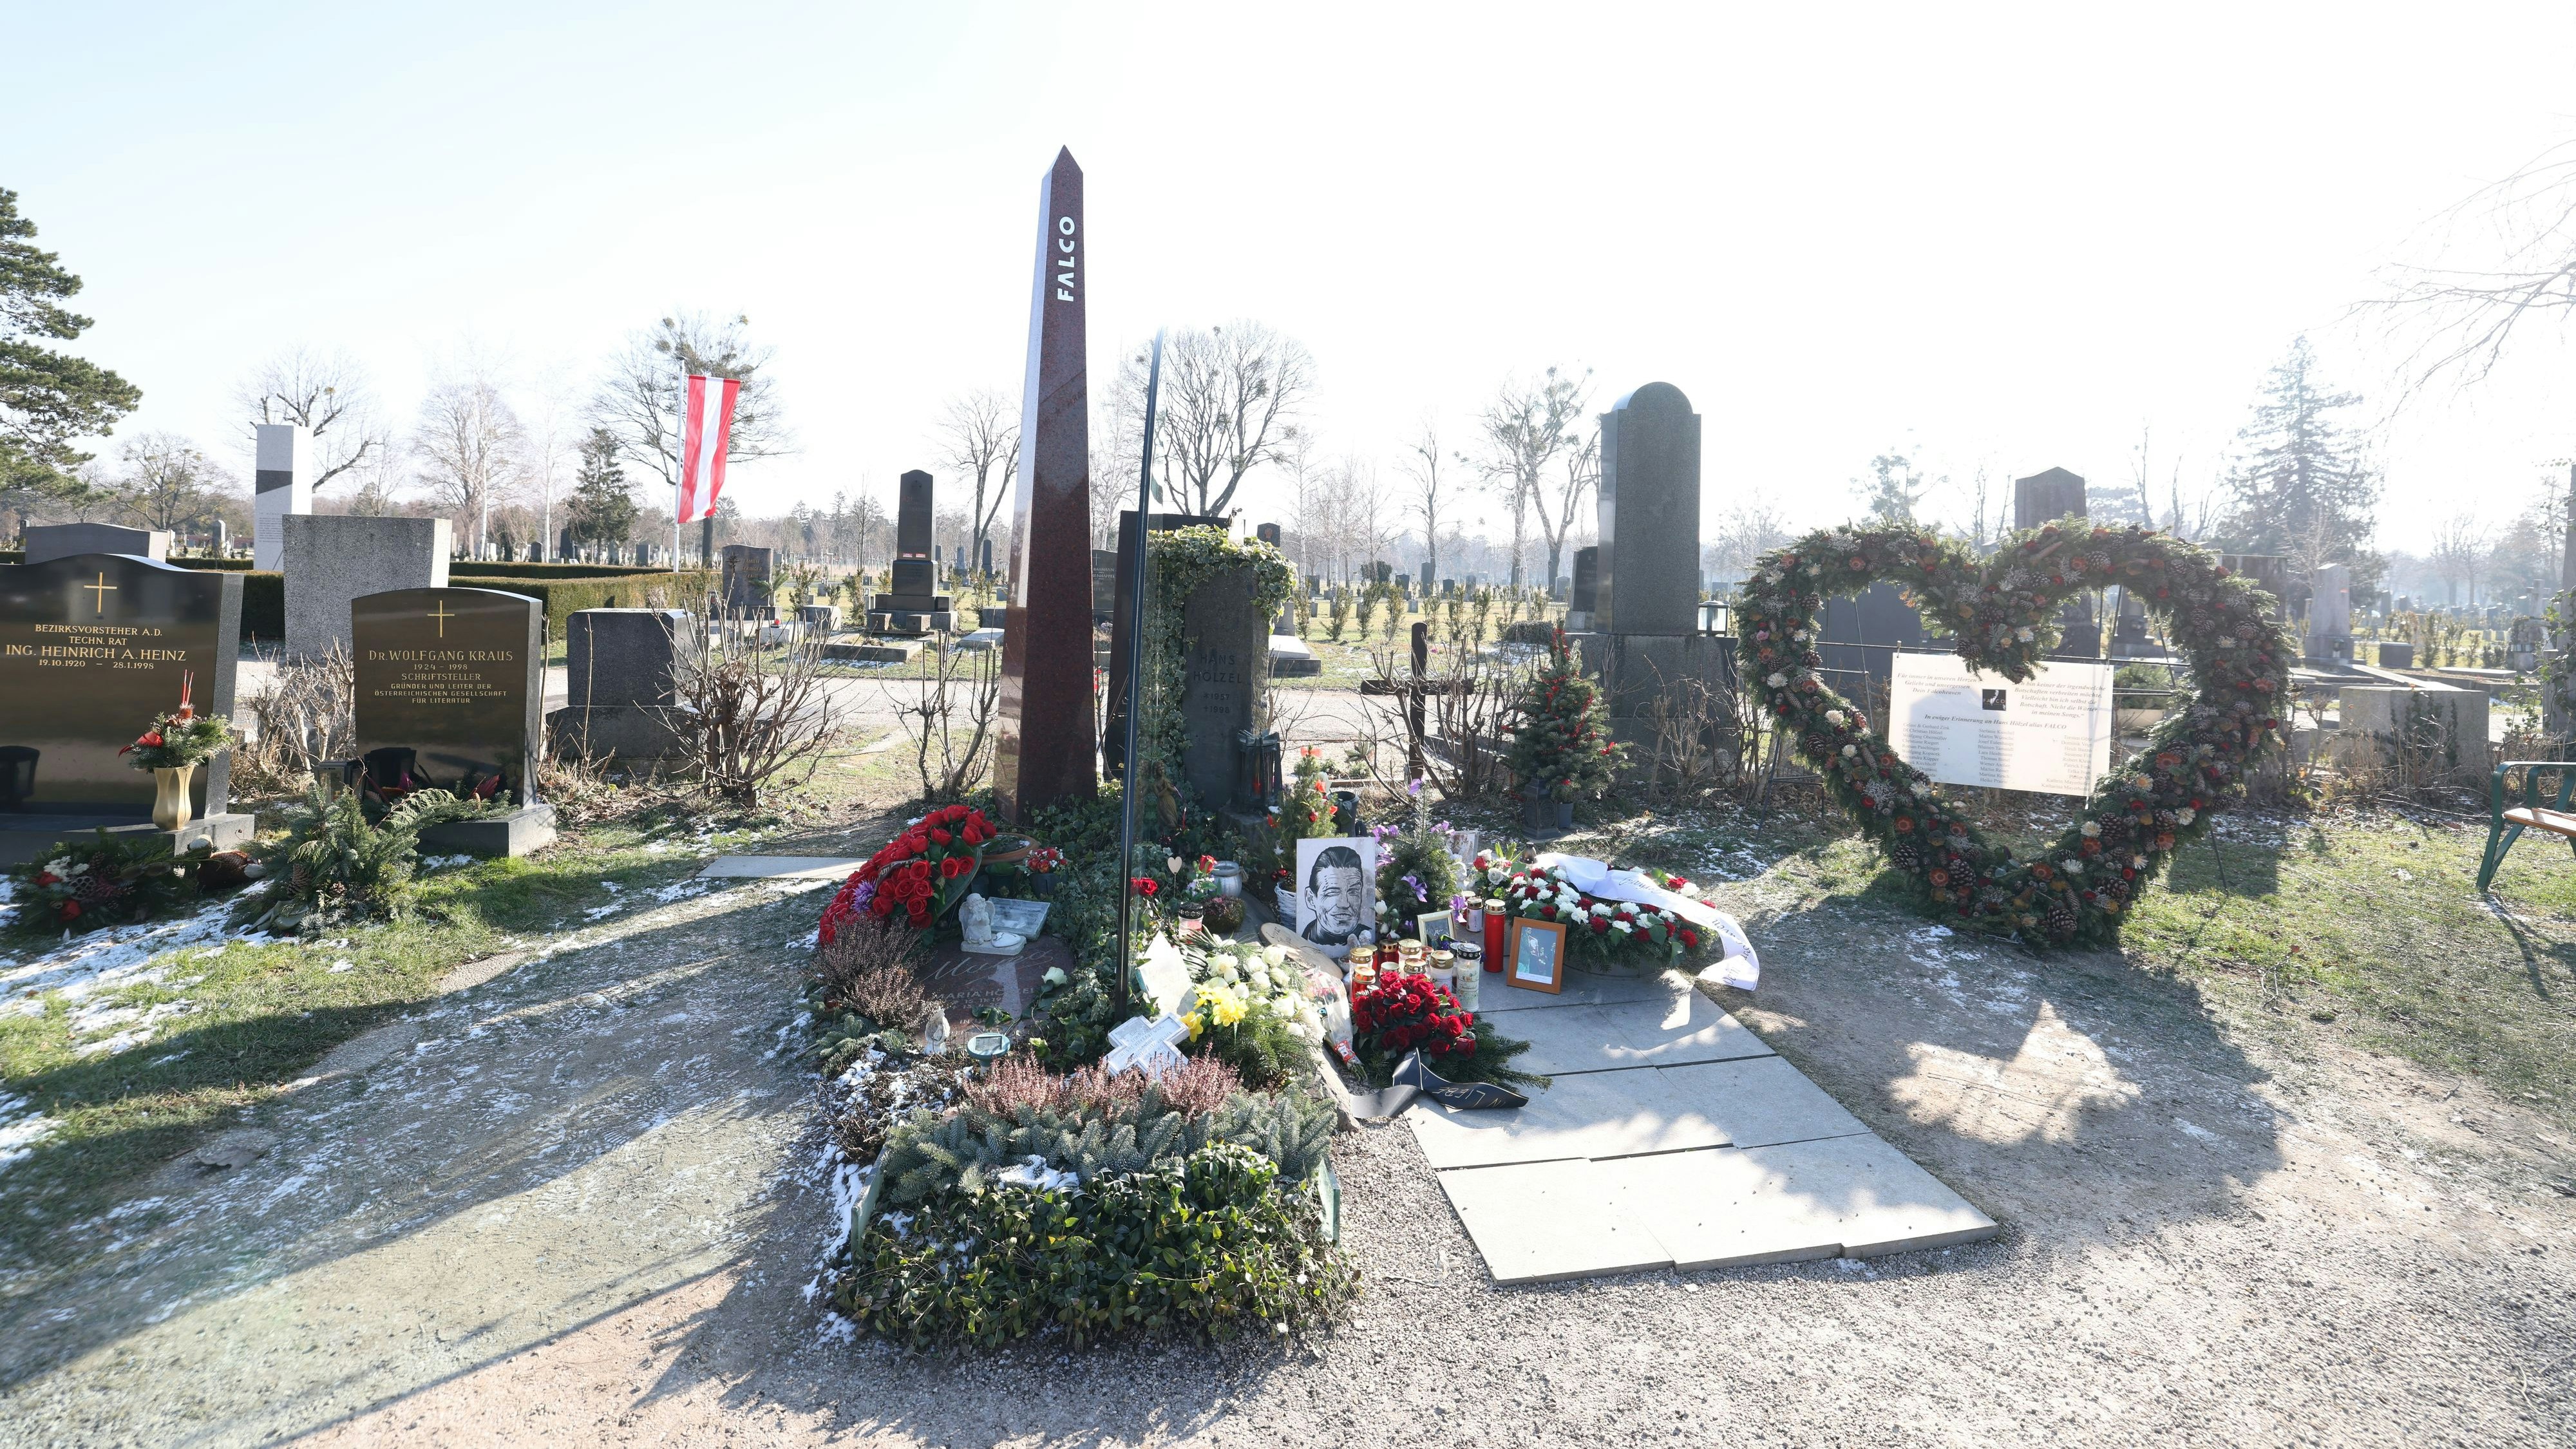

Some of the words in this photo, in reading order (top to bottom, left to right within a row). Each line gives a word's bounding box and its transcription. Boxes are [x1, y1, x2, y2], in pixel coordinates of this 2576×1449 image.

[1057, 216, 1075, 302] FALCO
[35, 624, 138, 636] BEZIRKSVORSTEHER
[142, 626, 162, 636] A.D.
[69, 636, 105, 645] TECHN.
[108, 636, 128, 646] RAT
[5, 644, 36, 657] ING.
[41, 645, 115, 659] HEINRICH
[121, 649, 138, 660] A.
[140, 649, 186, 661] HEINZ
[390, 650, 464, 661] WOLFGANG
[469, 651, 513, 661] KRAUS
[39, 659, 86, 667] 19.10.1920
[113, 661, 154, 670] 28.1.1998
[1200, 653, 1236, 665] HANS
[401, 672, 480, 681] SCHRIFTSTELLER
[1193, 670, 1242, 683] HÖLZEL
[937, 990, 981, 999] MARIA
[1432, 1086, 1486, 1108] LIEBE
